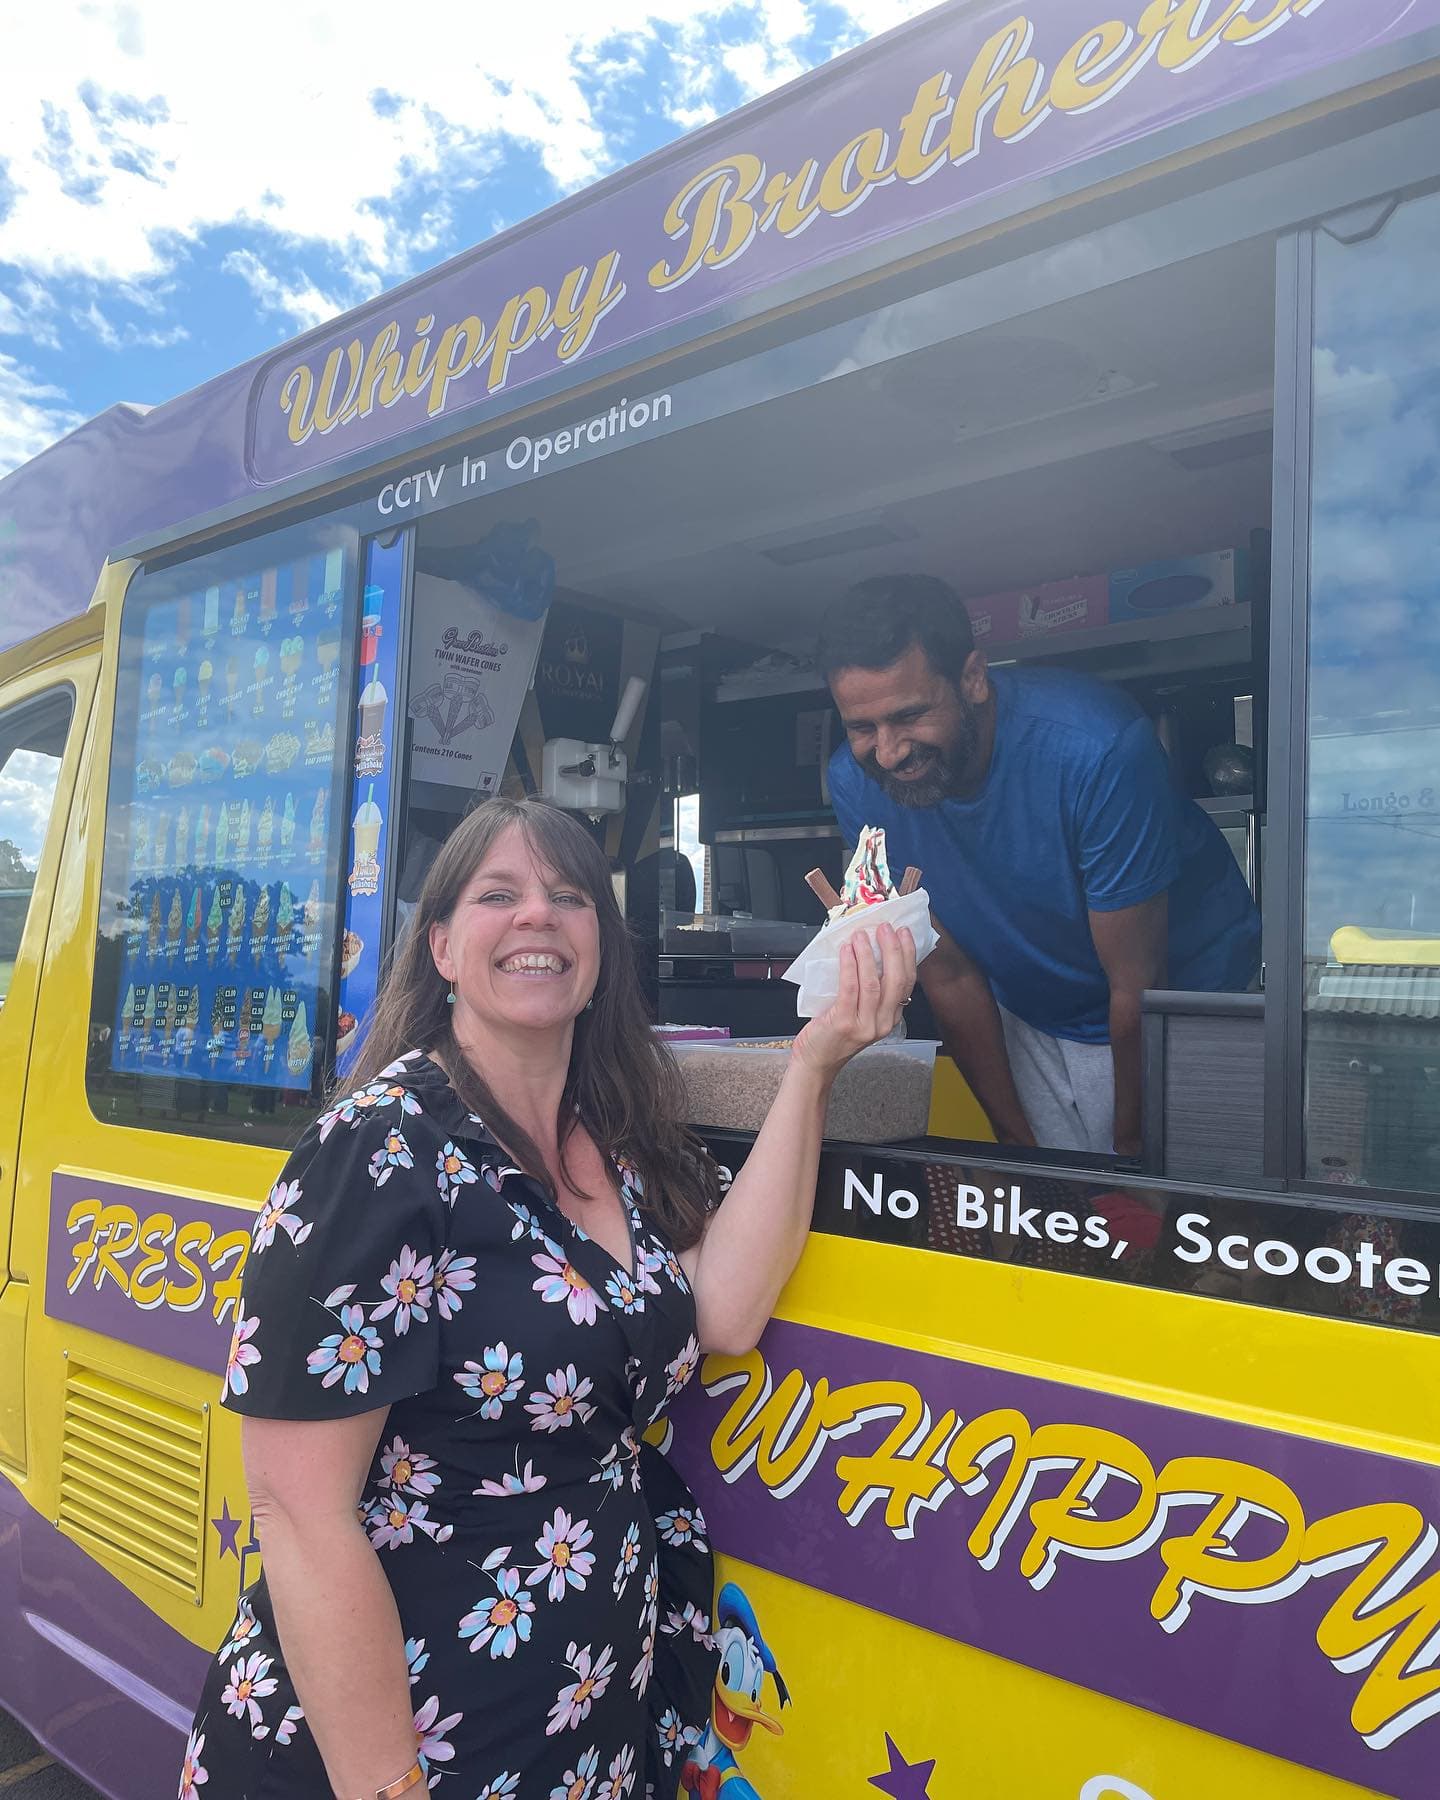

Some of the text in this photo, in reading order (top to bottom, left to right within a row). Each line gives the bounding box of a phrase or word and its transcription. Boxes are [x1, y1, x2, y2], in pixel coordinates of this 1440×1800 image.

[281, 250, 626, 446] Whippy
[377, 394, 673, 515] CCTV In Operation
[434, 648, 502, 673] TWIN WAFER CONES
[411, 744, 473, 761] Contents 210 Cones
[1341, 787, 1435, 814] Longo &
[842, 1167, 1440, 1299] No Bikes, Scoote
[702, 1354, 1440, 1751] WHIPPY
